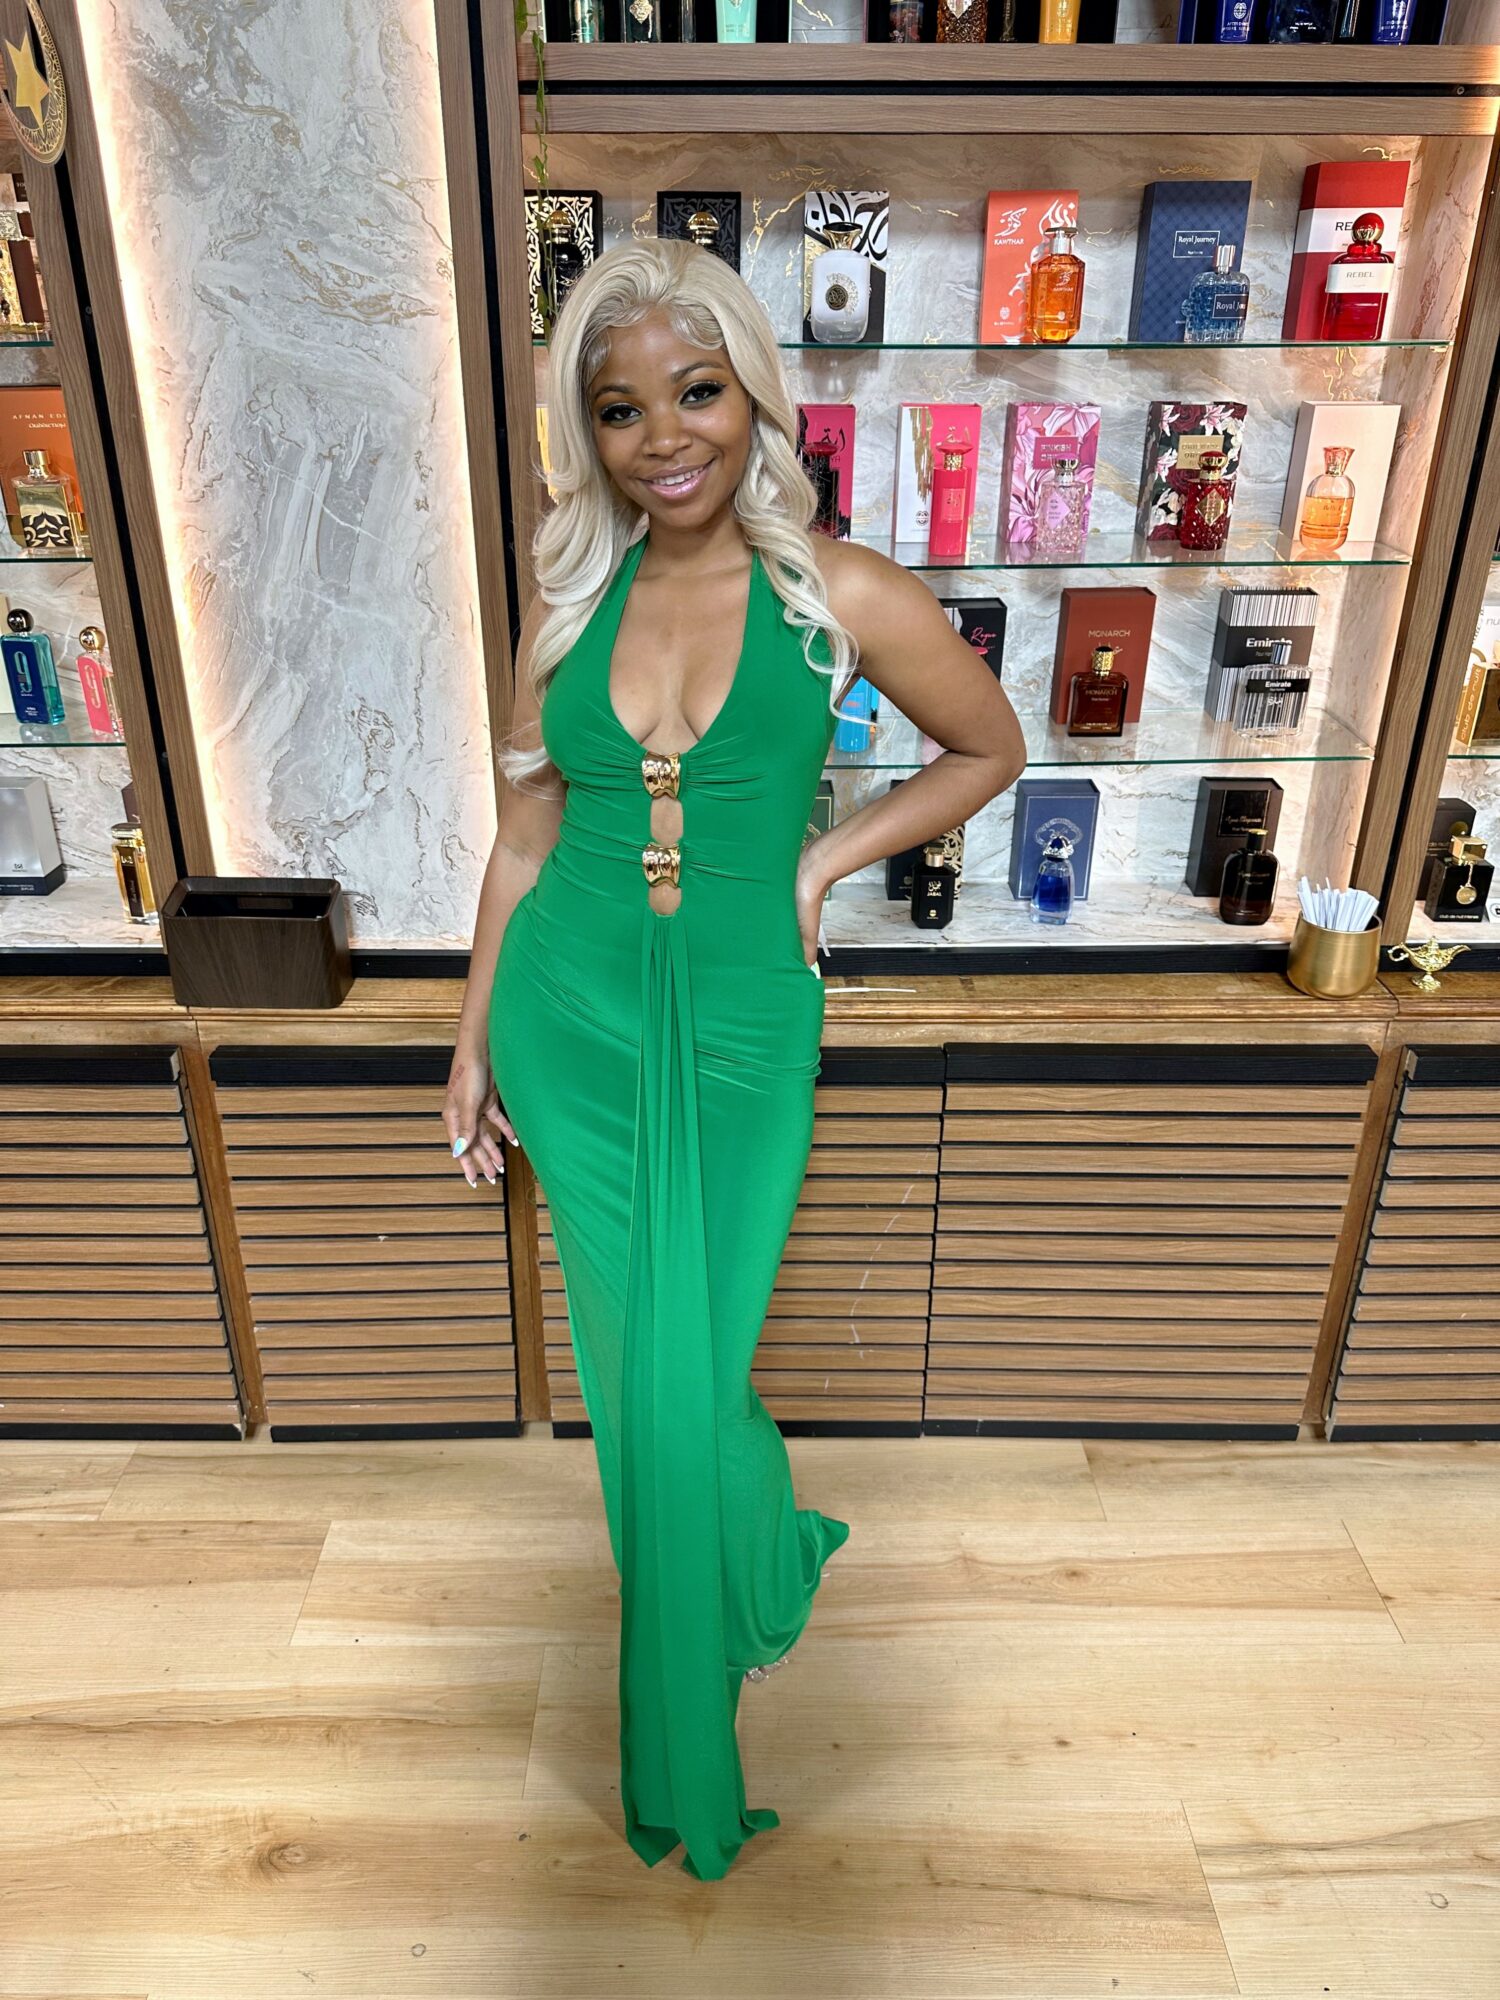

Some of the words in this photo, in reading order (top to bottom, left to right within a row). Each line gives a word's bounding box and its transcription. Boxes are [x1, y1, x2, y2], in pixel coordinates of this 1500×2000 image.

[994, 238, 1025, 246] KAWTHAR
[1178, 235, 1194, 245] Royal
[1194, 235, 1217, 245] Journey
[1346, 271, 1375, 279] REBEL
[1216, 300, 1235, 312] Royal
[1088, 629, 1131, 638] MONARCH
[1265, 680, 1292, 688] Emirate
[1085, 688, 1118, 697] MONARCH
